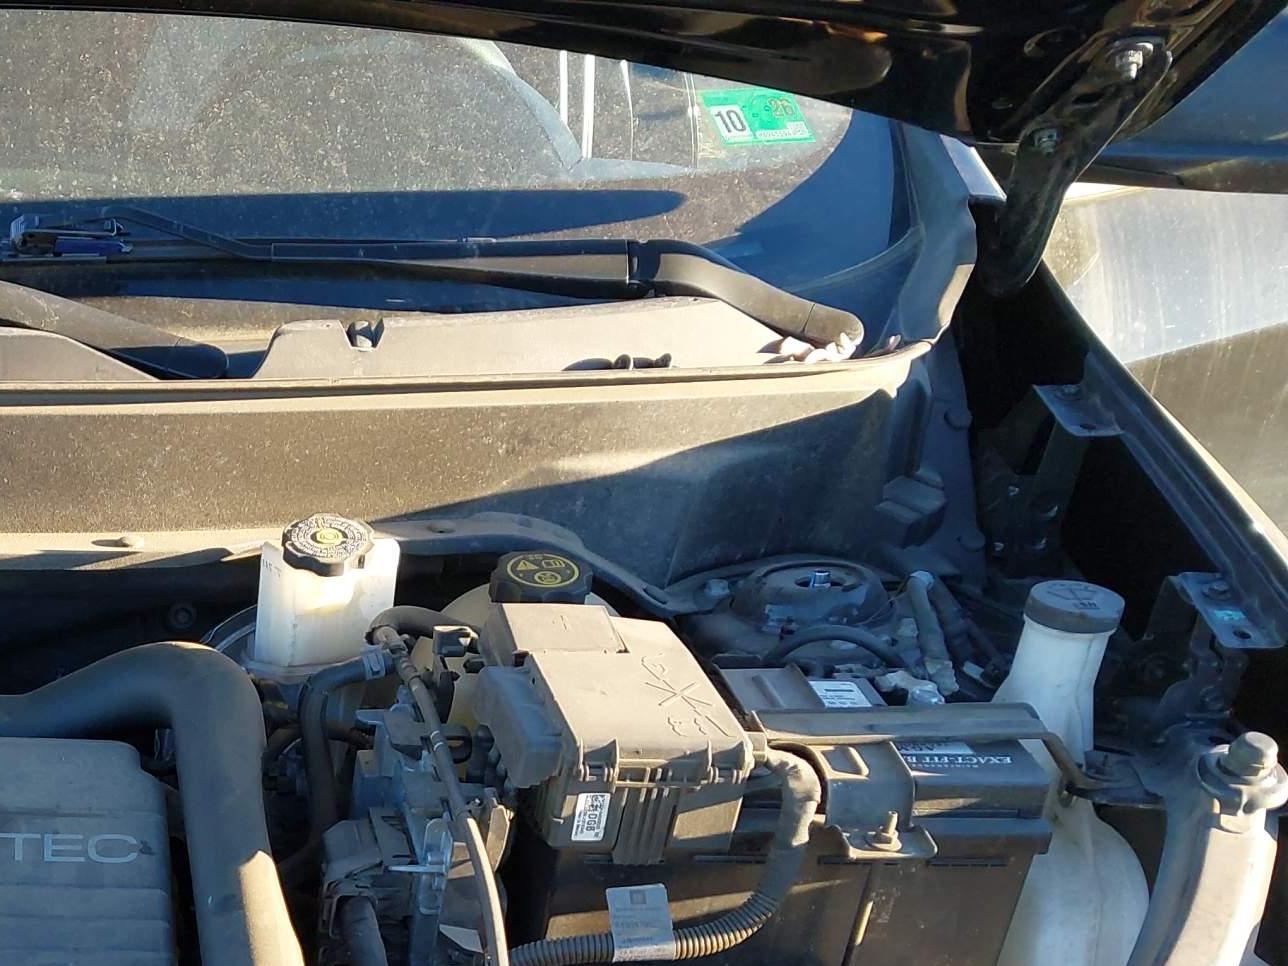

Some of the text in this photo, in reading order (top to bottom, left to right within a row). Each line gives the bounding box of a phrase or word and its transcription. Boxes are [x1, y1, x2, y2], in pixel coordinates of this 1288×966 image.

[768, 98, 795, 117] 26
[714, 110, 746, 133] 10
[922, 756, 1012, 764] EXACT-FIT
[585, 813, 599, 832] DGB
